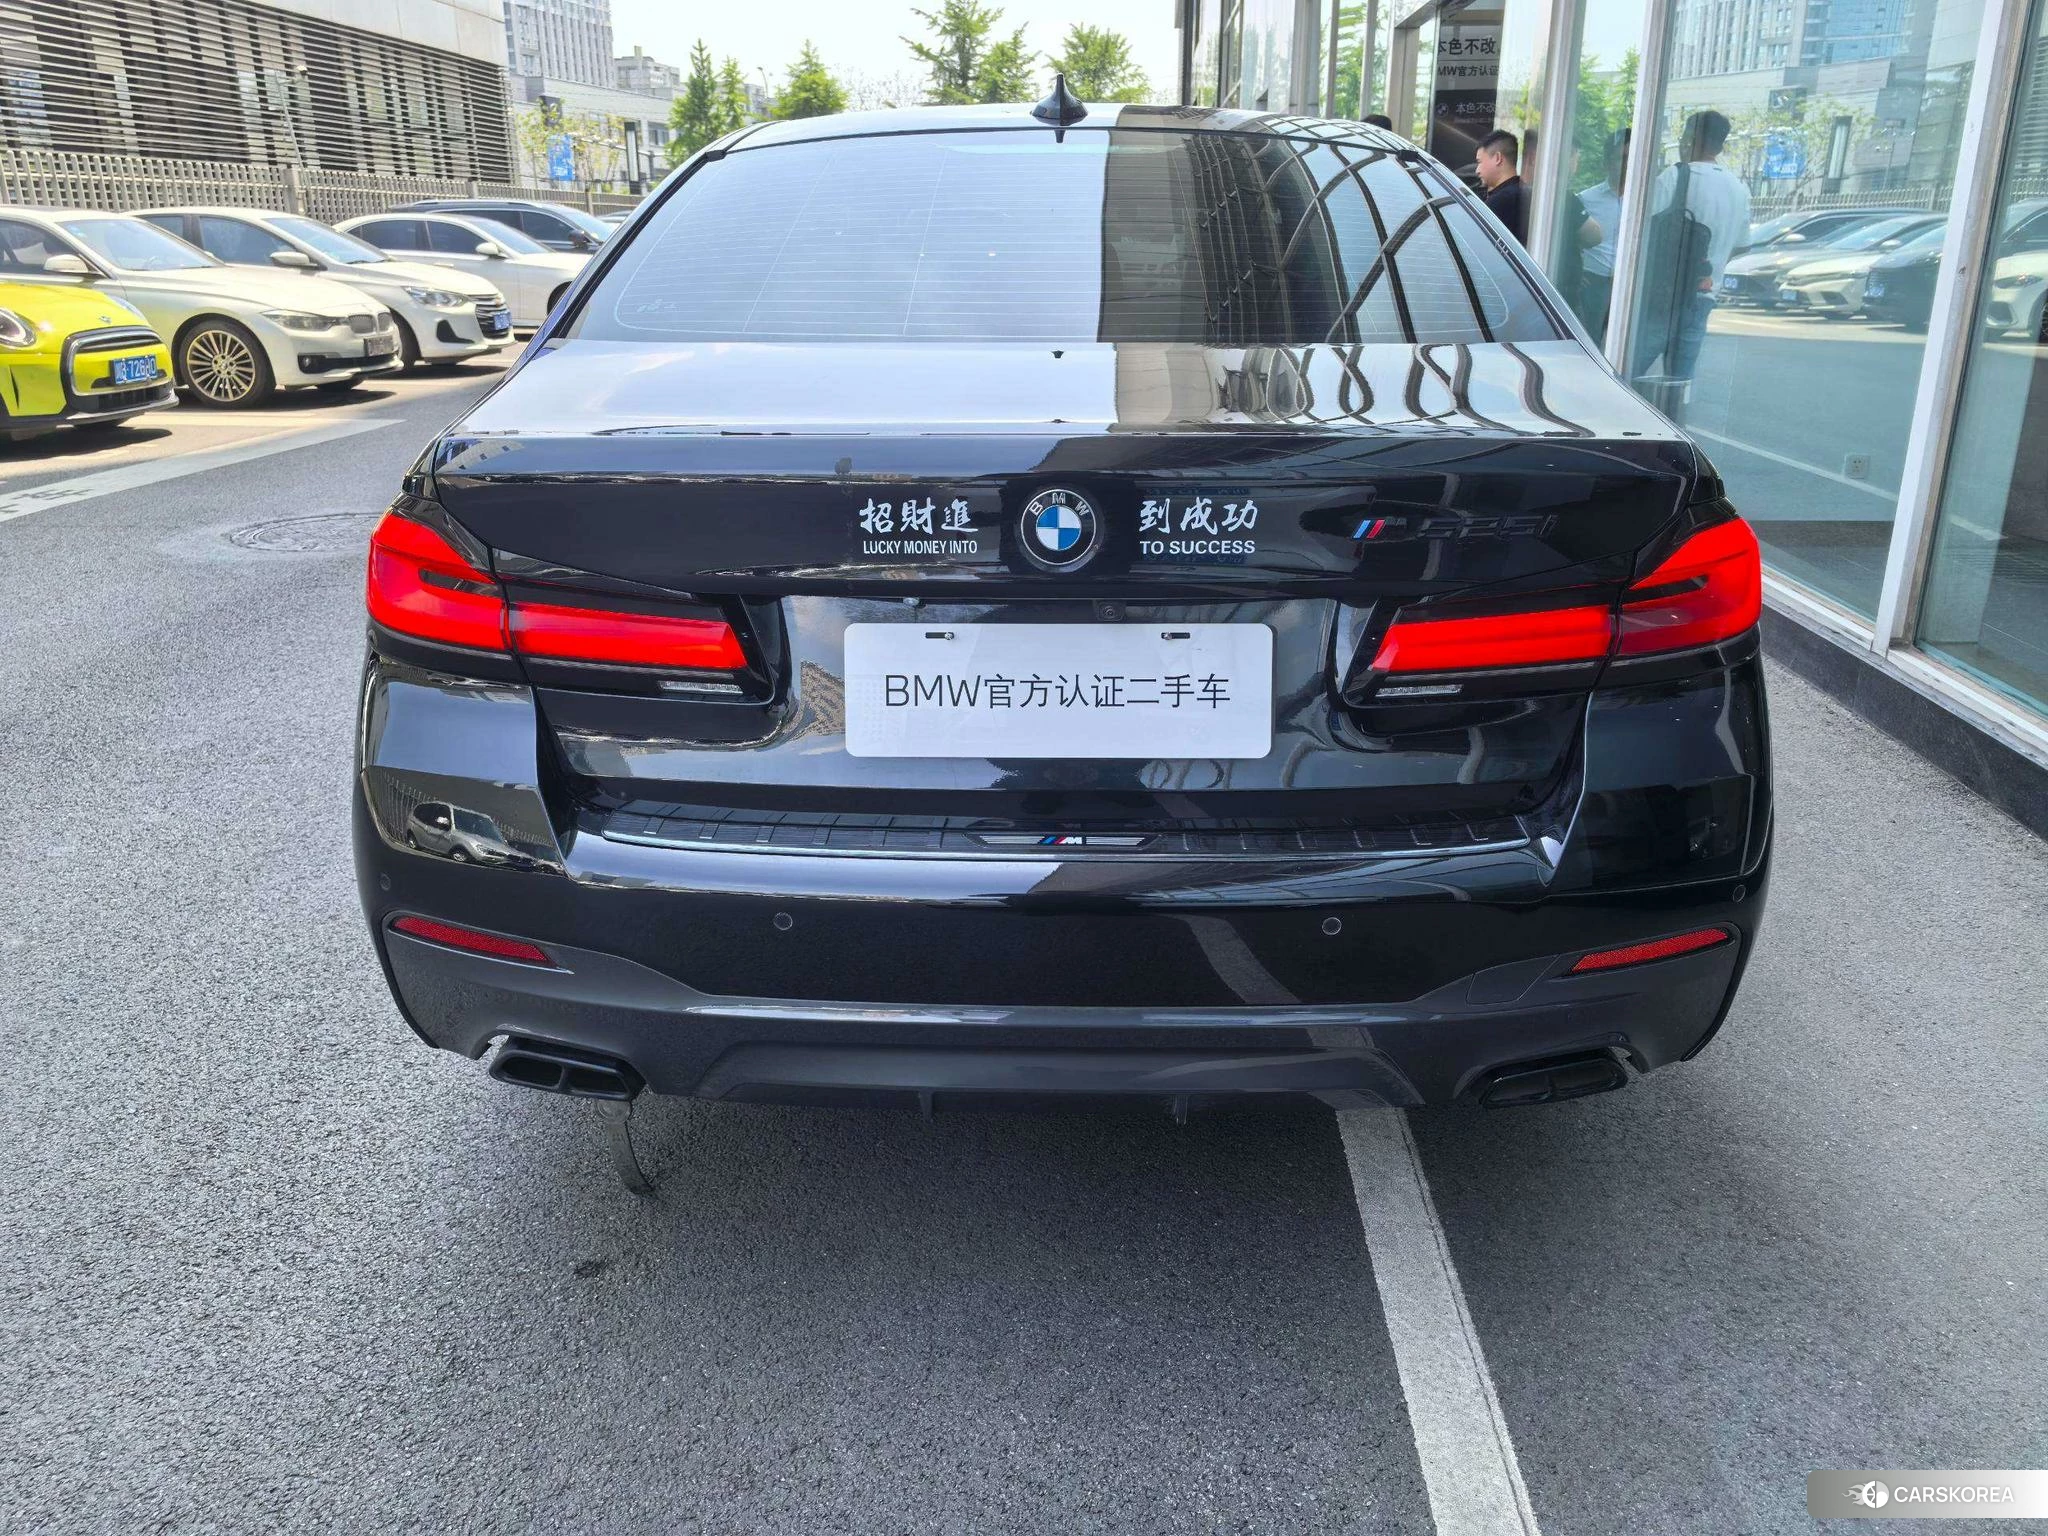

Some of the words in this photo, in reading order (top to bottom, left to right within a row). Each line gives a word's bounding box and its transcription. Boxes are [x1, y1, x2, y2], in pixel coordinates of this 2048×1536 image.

[859, 497, 979, 534] 招財進
[1029, 492, 1089, 516] BMW
[1138, 496, 1258, 535] 到成功
[863, 540, 901, 554] LUCKY
[904, 540, 947, 554] MONEY
[949, 540, 978, 554] INTO
[1140, 540, 1165, 555] TO
[1169, 540, 1256, 555] SUCCESS
[884, 673, 1231, 709] BMW官方认证二手车
